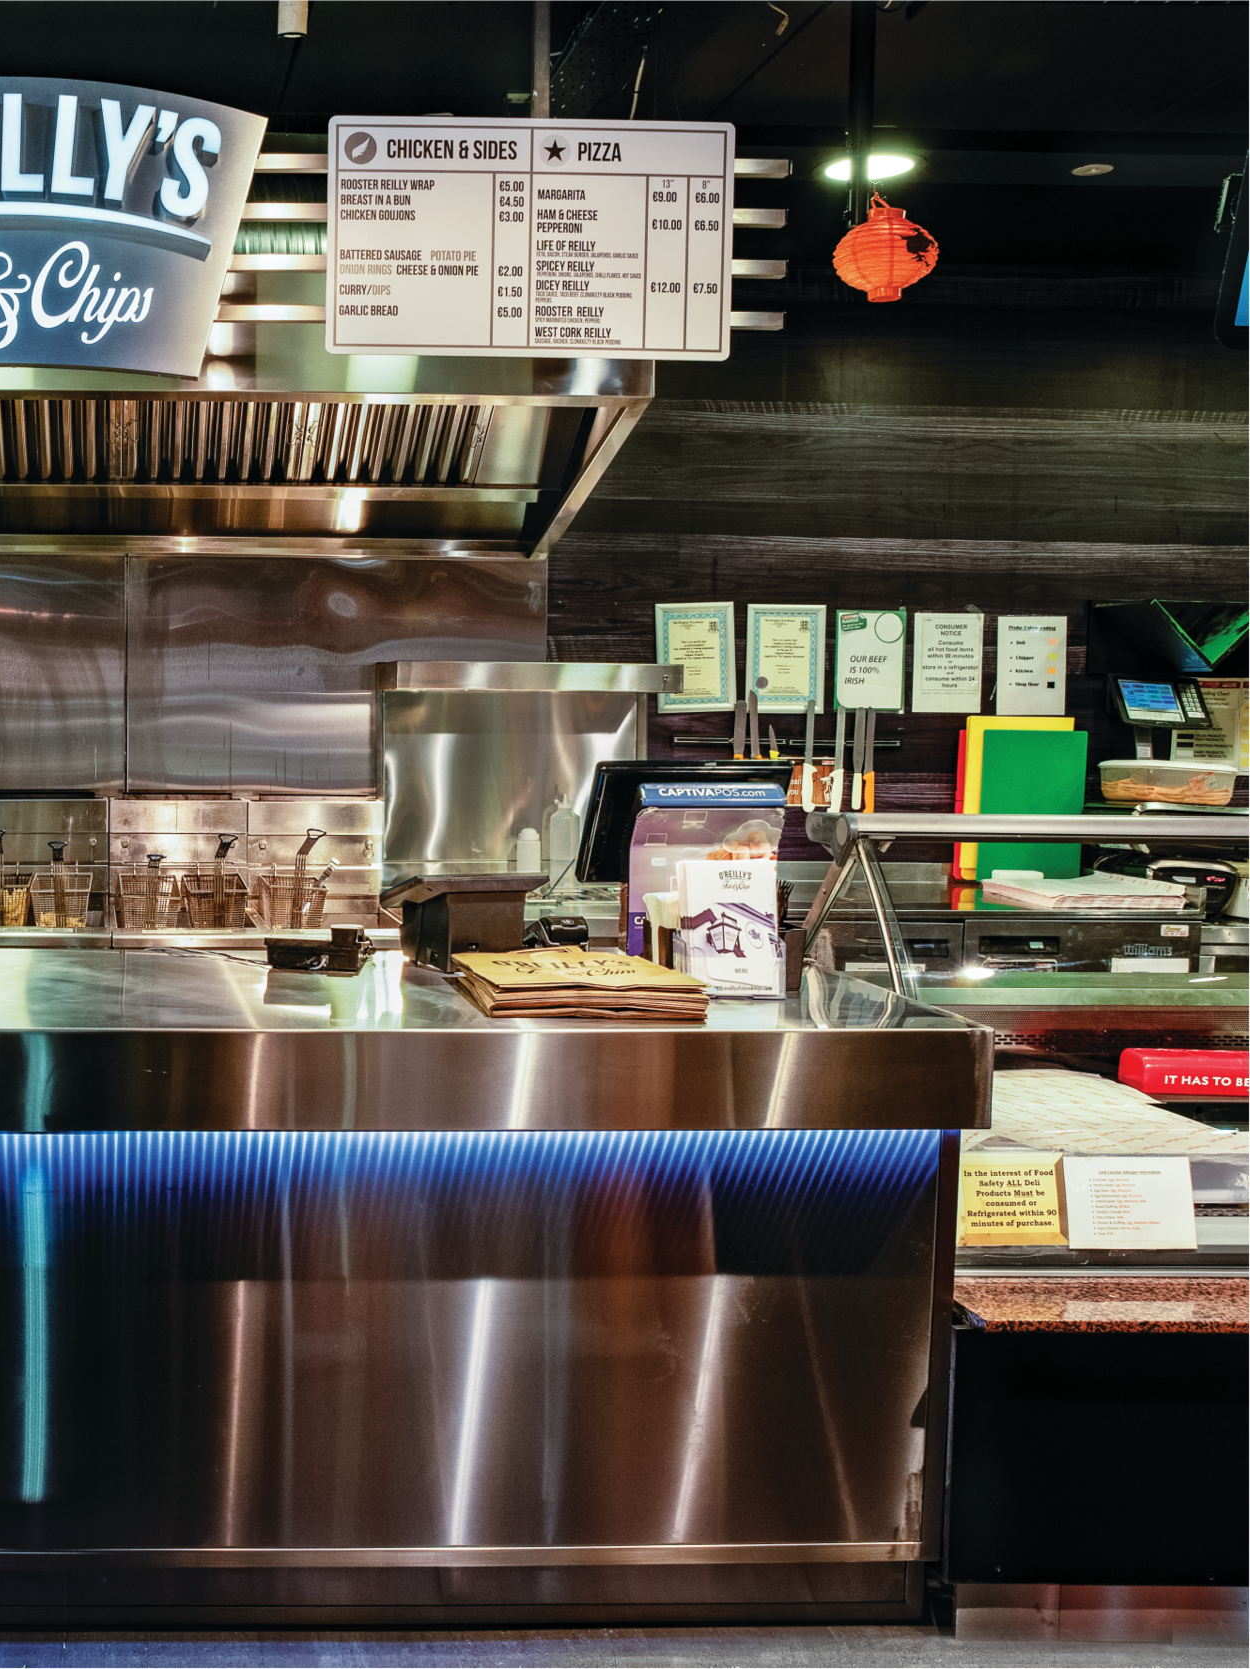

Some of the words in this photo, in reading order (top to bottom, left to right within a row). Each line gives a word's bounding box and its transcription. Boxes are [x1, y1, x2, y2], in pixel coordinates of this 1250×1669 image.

[387, 139, 454, 159] CHICKEN
[459, 140, 469, 159] &
[473, 141, 517, 160] SIDES
[578, 142, 621, 162] PIZZA
[341, 179, 378, 190] ROOSTER
[380, 180, 408, 190] REILLY
[410, 180, 435, 191] WRAP
[499, 181, 524, 191] €5.00
[538, 190, 585, 200] MARGARITA
[653, 192, 677, 202] €9.00
[695, 193, 719, 203] €6.00
[341, 195, 373, 205] BREAST
[375, 195, 383, 205] IN
[385, 195, 391, 205] A
[394, 195, 411, 206] BUN
[499, 197, 524, 207] €4.50
[537, 223, 582, 233] PEPPERONI
[652, 219, 682, 230] €10.00
[537, 241, 554, 251] LIFE
[556, 241, 566, 251] OF
[568, 241, 595, 251] REILLY
[340, 250, 382, 260] BATTERED
[384, 250, 421, 261] SAUSAGE
[431, 251, 461, 261] POTATO
[463, 251, 476, 261] PIE
[31, 241, 154, 344] Chips
[339, 285, 391, 296] CURRY/DIPS
[498, 287, 522, 297] €1.50
[651, 282, 680, 293] €12.00
[693, 284, 717, 294] €7.50
[339, 305, 368, 316] GARLIC
[371, 306, 398, 316] BREAD
[659, 788, 766, 797] CAPTIVAPOS.com
[1123, 943, 1173, 956] williams
[1164, 1075, 1178, 1084] IT
[1181, 1076, 1209, 1086] HAS
[1213, 1077, 1231, 1086] TO
[1236, 1078, 1250, 1087] BE
[979, 1180, 1004, 1188] Safety
[967, 1210, 1016, 1218] Refrigerated
[1016, 1220, 1054, 1228] purchase.
